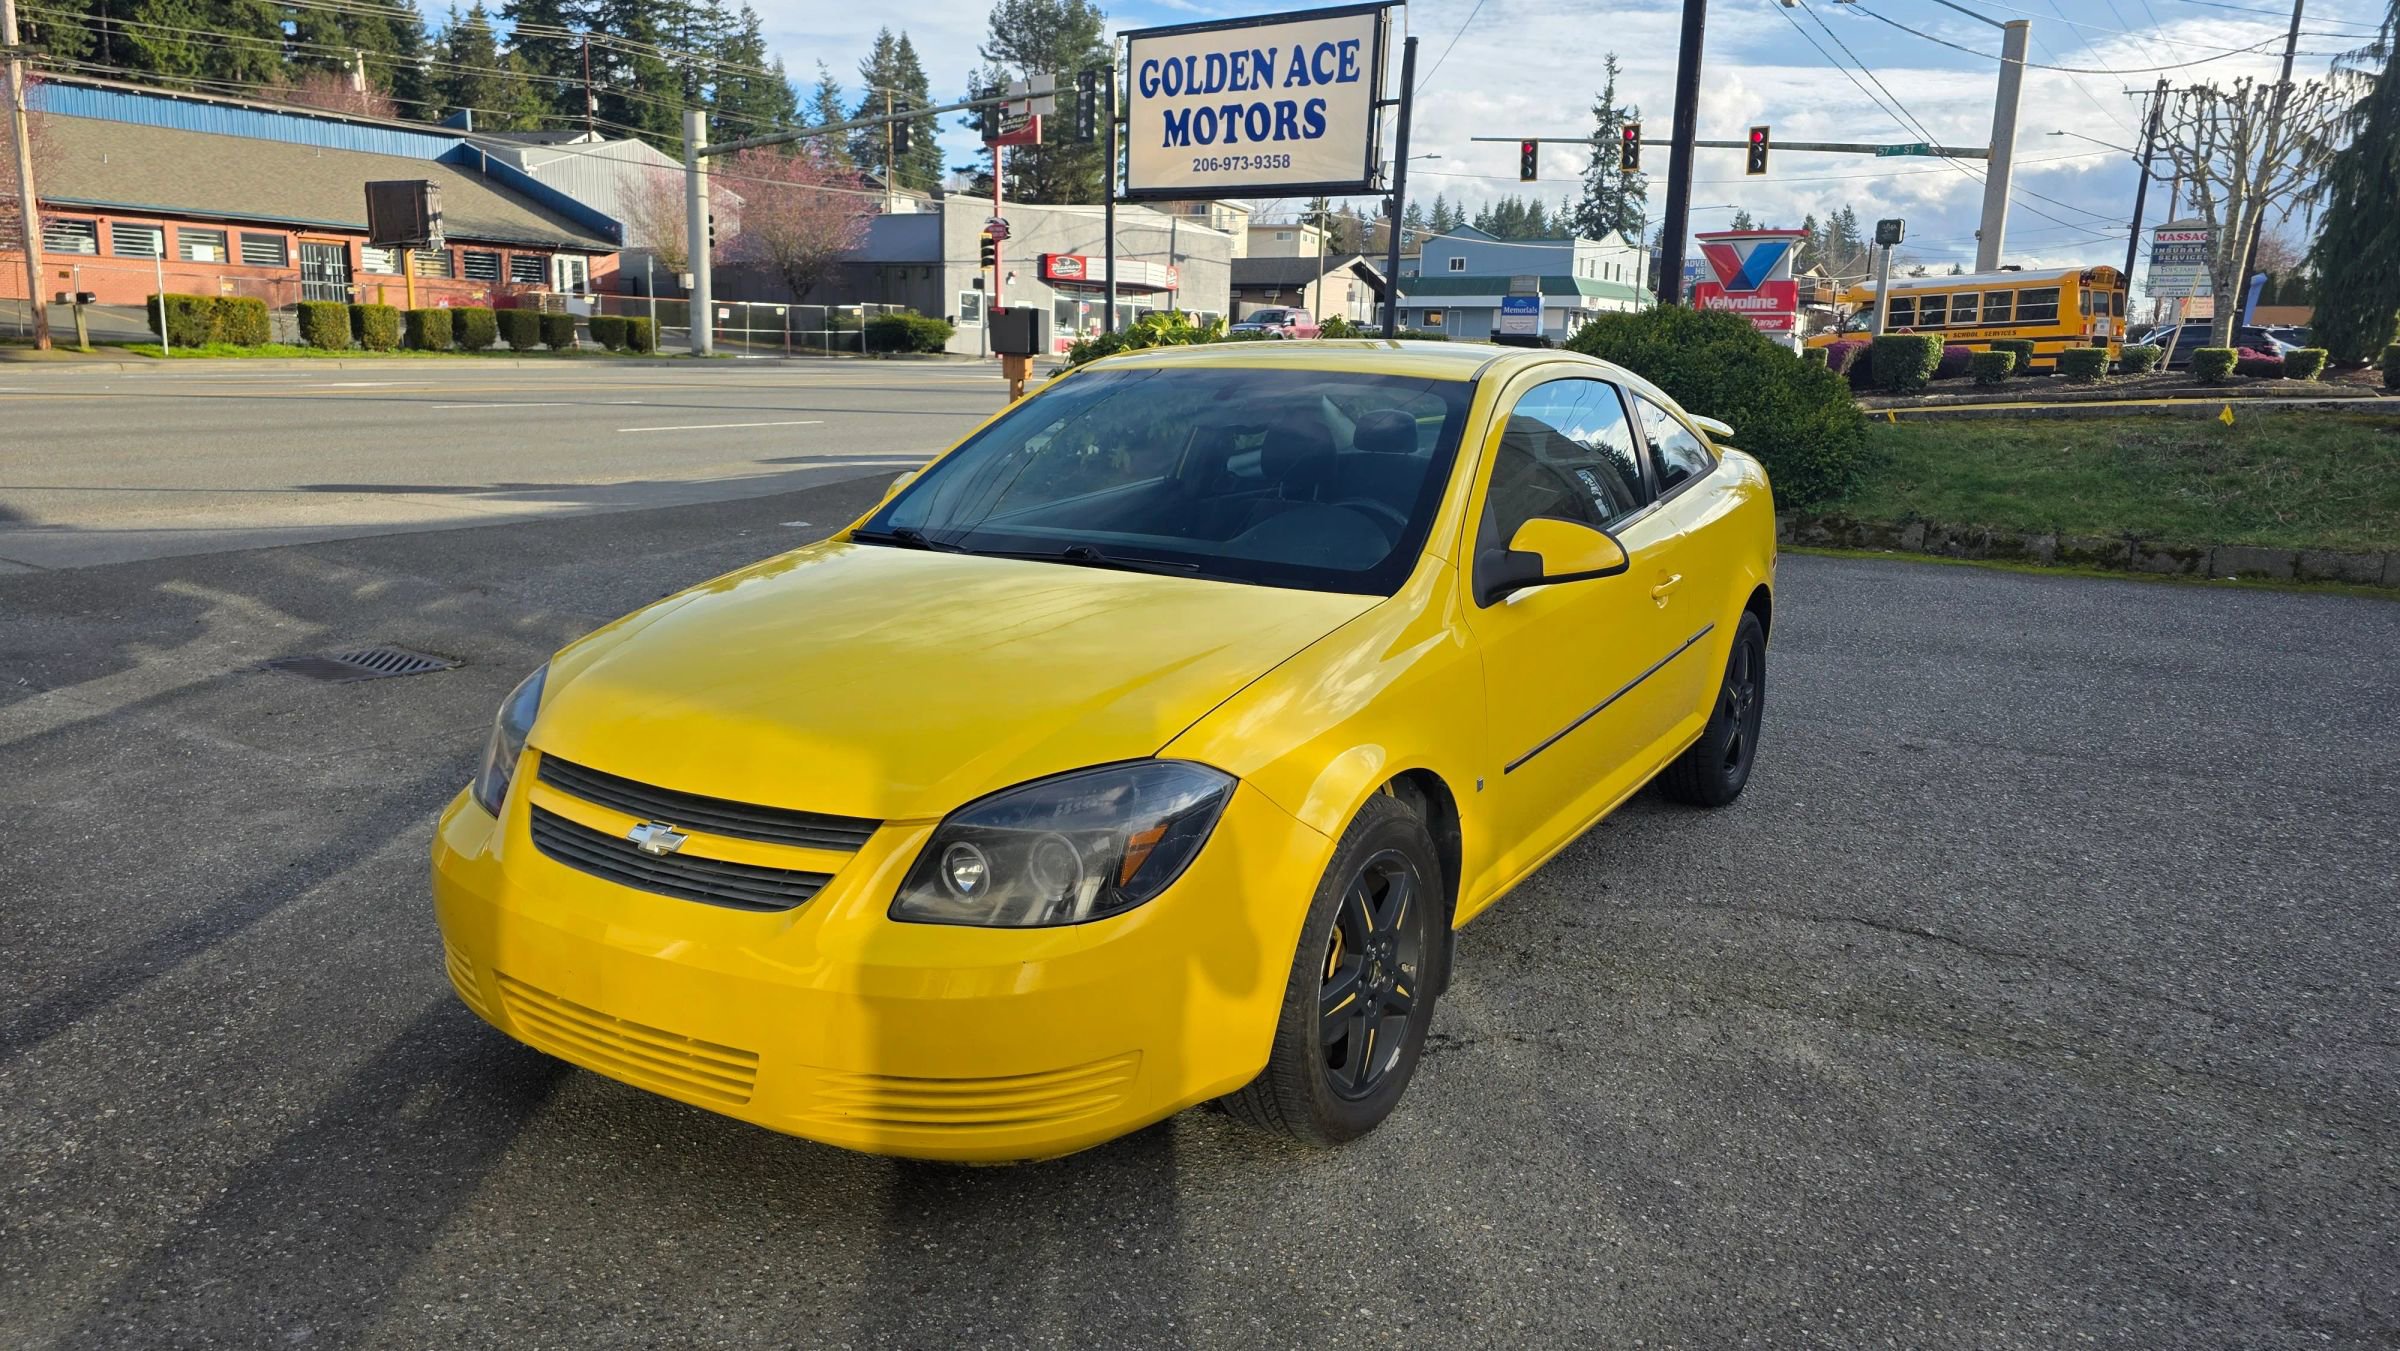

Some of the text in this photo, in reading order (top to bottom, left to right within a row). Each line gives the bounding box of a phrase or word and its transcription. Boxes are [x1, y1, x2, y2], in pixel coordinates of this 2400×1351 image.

[1139, 39, 1361, 99] GOLDEN ACE
[1162, 98, 1327, 147] MOTORS
[1192, 154, 1291, 172] 206-973-9358
[2156, 232, 2209, 241] MASSAG
[1705, 295, 1778, 309] Valvoline
[1503, 306, 1538, 314] Memorials
[1751, 318, 1783, 328] hange
